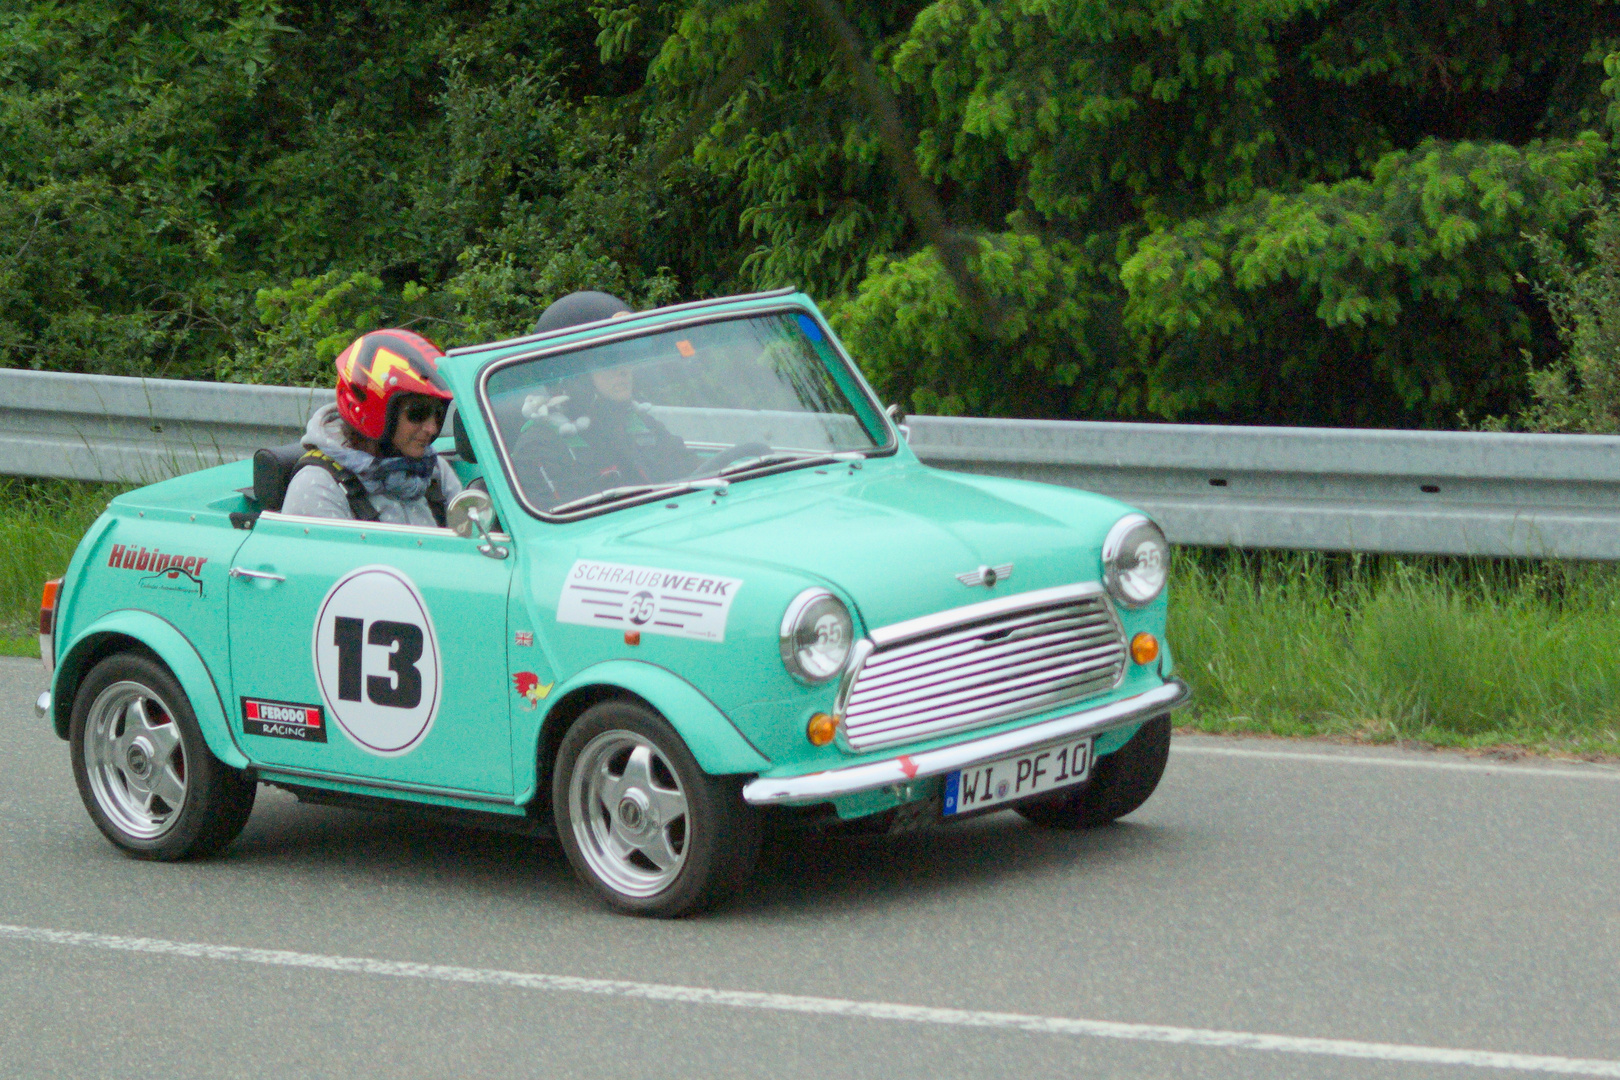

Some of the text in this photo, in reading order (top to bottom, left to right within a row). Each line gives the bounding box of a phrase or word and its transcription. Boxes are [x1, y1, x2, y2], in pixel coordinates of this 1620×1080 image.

[108, 544, 208, 579] Hübinger
[1135, 549, 1159, 570] 65
[574, 564, 733, 596] SCHRAUBWERK
[628, 596, 655, 622] 65
[816, 622, 841, 645] 65
[333, 616, 424, 710] 13
[260, 705, 305, 723] FERODO
[262, 724, 306, 738] RACING
[962, 743, 1087, 806] WI PF 10
